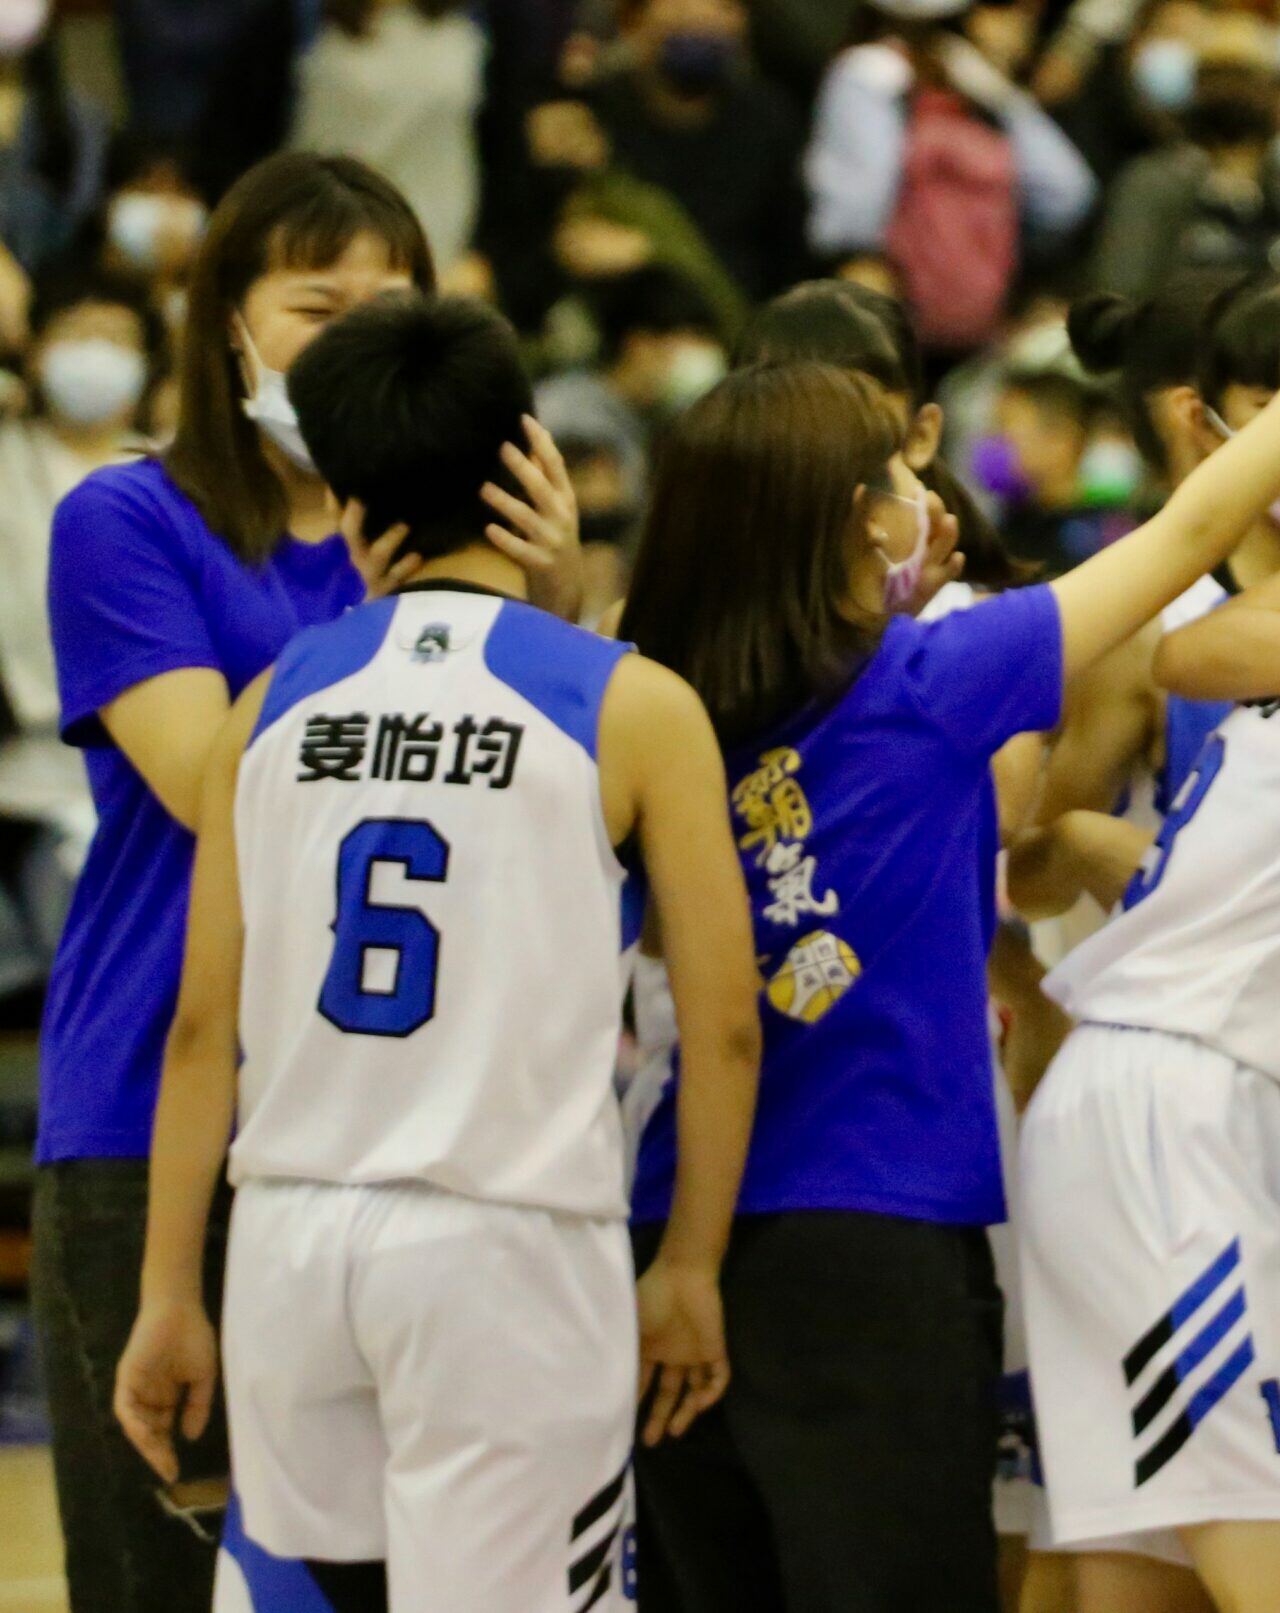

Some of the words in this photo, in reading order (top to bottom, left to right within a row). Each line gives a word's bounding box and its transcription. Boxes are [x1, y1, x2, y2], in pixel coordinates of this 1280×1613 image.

[296, 711, 525, 790] 姜怡均
[317, 816, 451, 1038] 6
